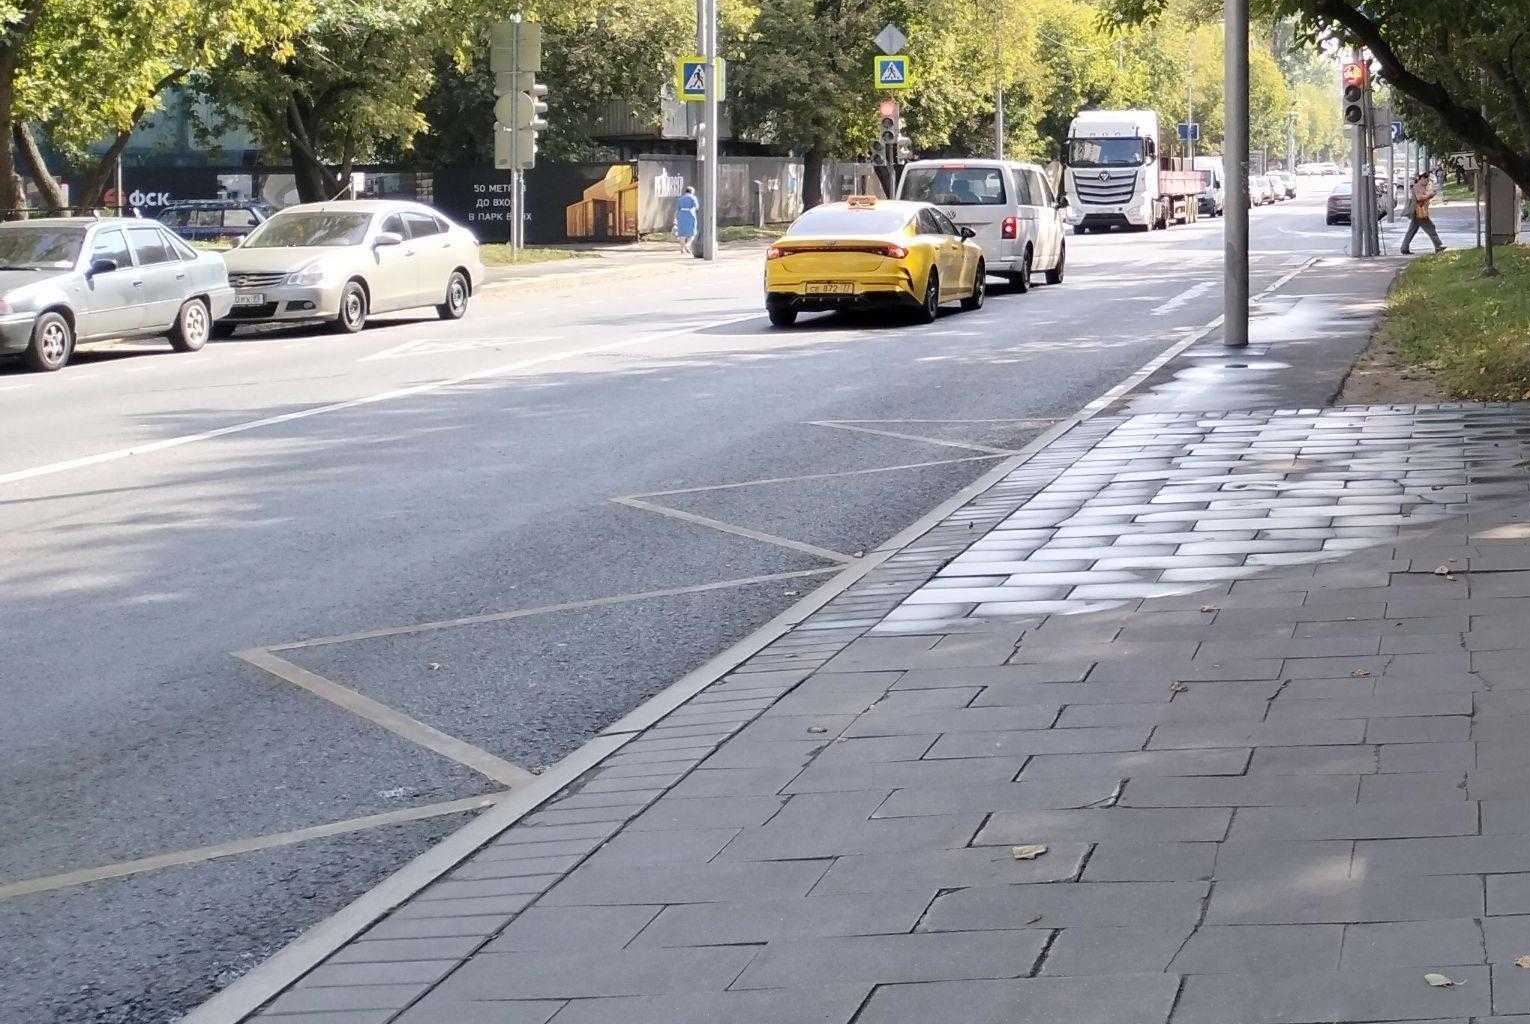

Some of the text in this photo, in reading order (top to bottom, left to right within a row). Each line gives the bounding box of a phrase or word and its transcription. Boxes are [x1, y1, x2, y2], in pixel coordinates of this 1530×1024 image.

[473, 184, 486, 193] 50
[476, 198, 490, 207] ДО
[478, 212, 503, 221] ПАРК
